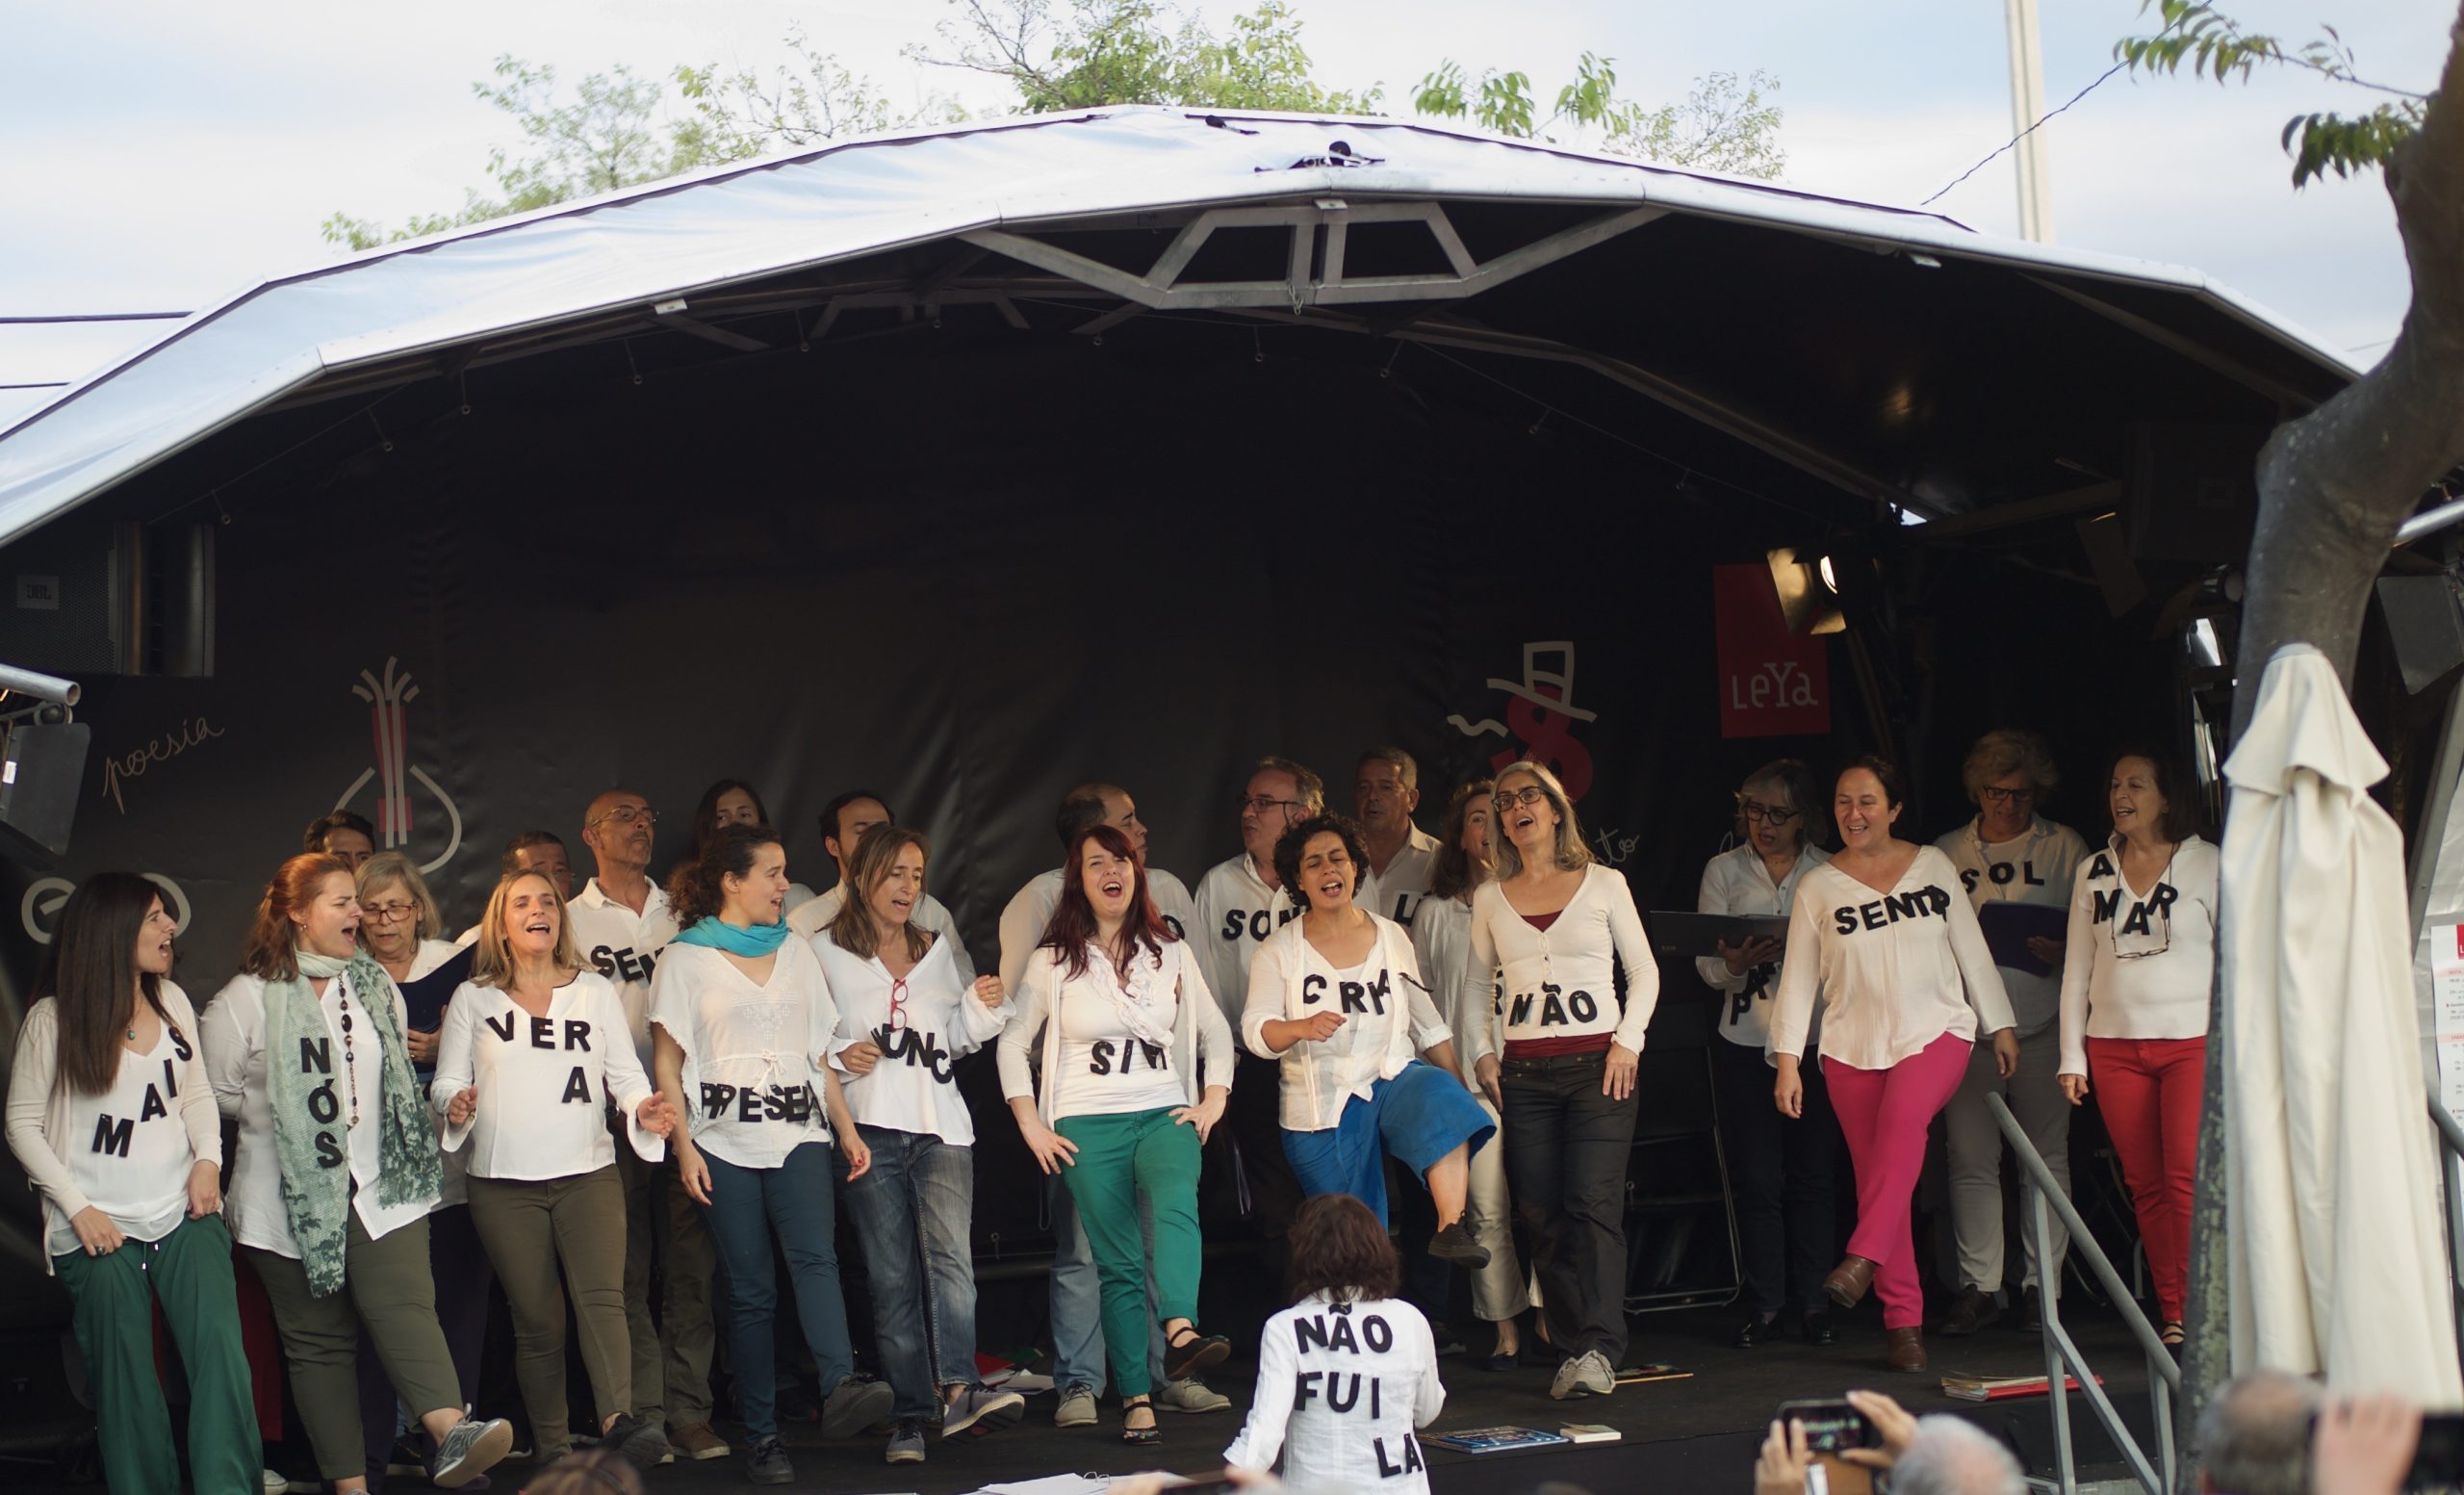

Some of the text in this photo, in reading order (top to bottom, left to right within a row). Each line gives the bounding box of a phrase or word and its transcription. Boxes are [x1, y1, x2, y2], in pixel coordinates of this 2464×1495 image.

[1732, 661, 1818, 709] LeYa
[102, 717, 225, 815] poesia
[1961, 860, 2045, 896] SOL
[1508, 981, 1598, 1026] NÃO
[91, 1026, 192, 1158] MAIS
[299, 1037, 344, 1169] NÓS
[1294, 1302, 1393, 1354] NÃO
[1295, 1371, 1380, 1420] FUI
[1373, 1432, 1424, 1479] LA
